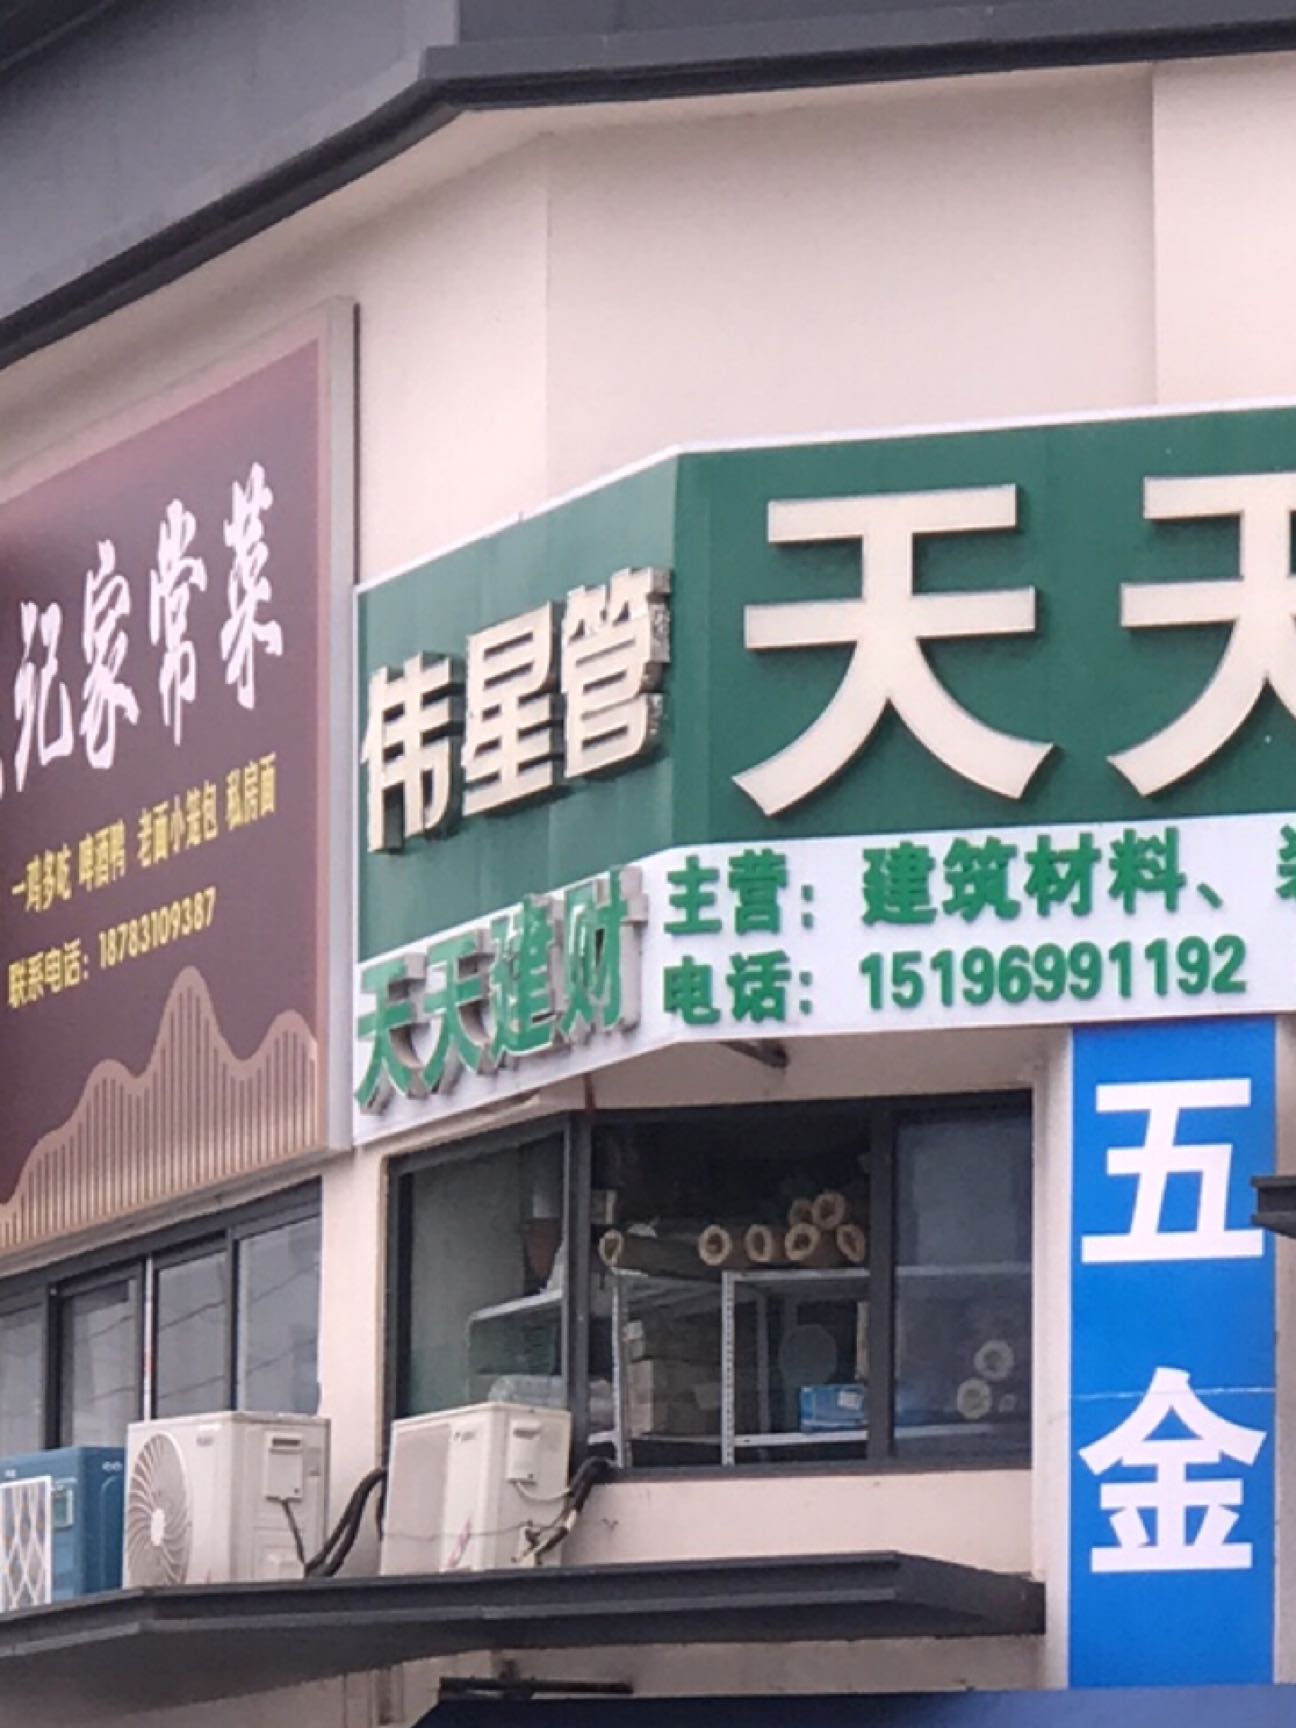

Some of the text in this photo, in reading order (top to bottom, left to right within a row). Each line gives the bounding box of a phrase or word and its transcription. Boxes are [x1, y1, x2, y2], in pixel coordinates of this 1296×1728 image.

[361, 567, 671, 852] 伟星管
[355, 865, 646, 1114] 天天建财
[859, 934, 1247, 1010] 15196991192
